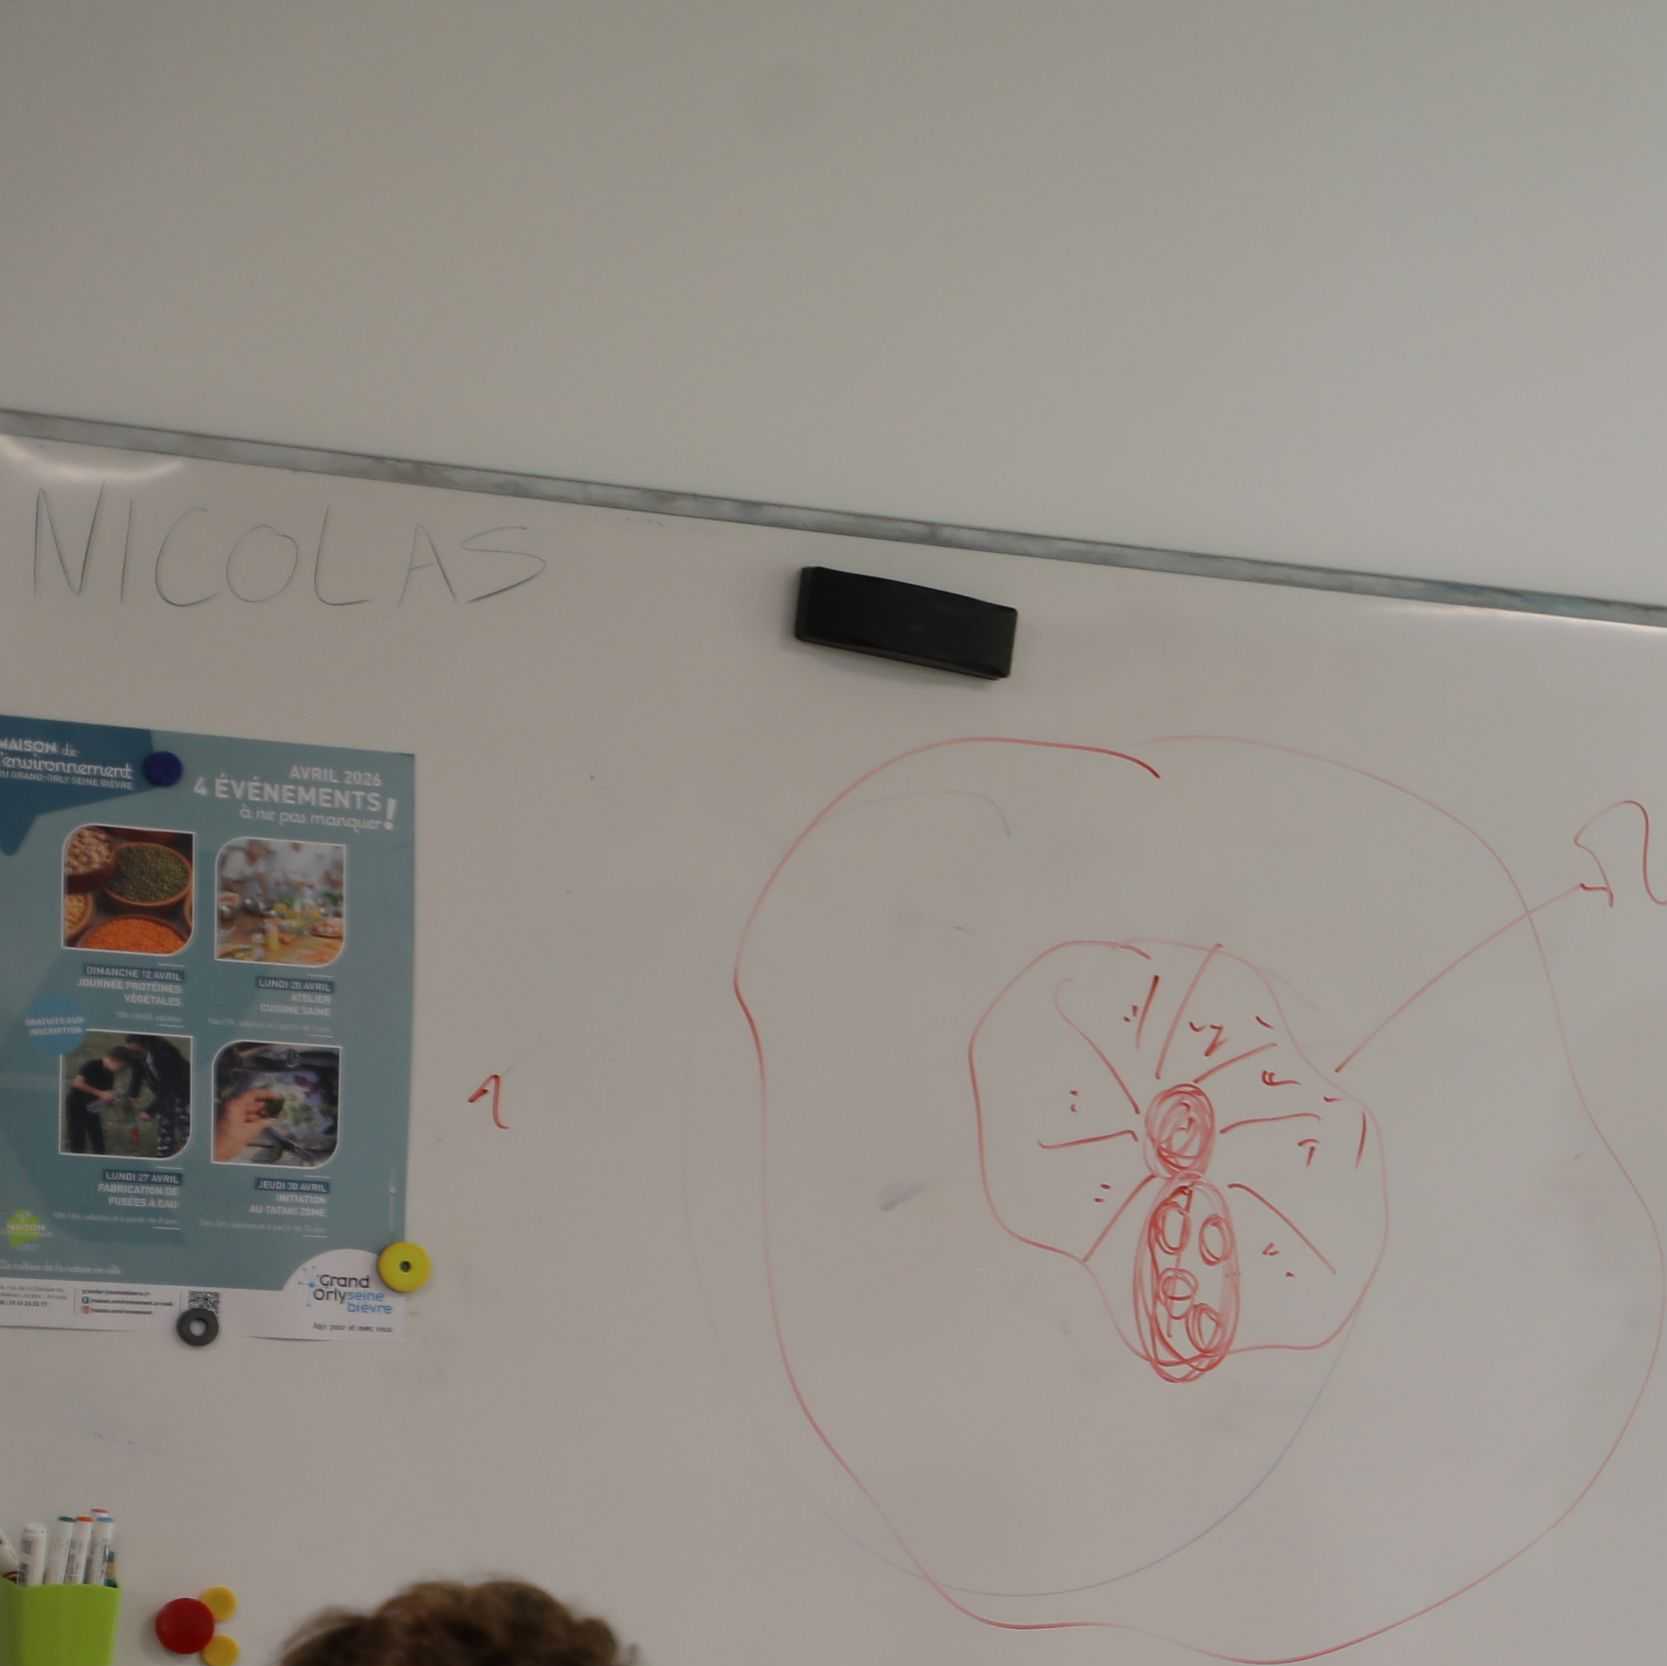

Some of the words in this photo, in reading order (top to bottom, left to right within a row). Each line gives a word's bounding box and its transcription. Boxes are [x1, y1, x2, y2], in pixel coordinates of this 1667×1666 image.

[33, 483, 547, 608] NICOLAS
[0, 752, 133, 779] 'environnement
[289, 764, 340, 783] AVRIL
[343, 770, 384, 787] 2026
[193, 777, 208, 796] 4
[256, 810, 275, 822] ne
[279, 811, 306, 825] pas
[310, 813, 383, 833] manquer
[86, 965, 139, 978] DIMANCHE
[303, 982, 332, 993] AVRIL
[105, 1171, 136, 1180] LUNDI
[151, 1174, 178, 1184] AVRIL
[320, 1274, 370, 1288] Grand
[313, 1288, 346, 1304] Orly
